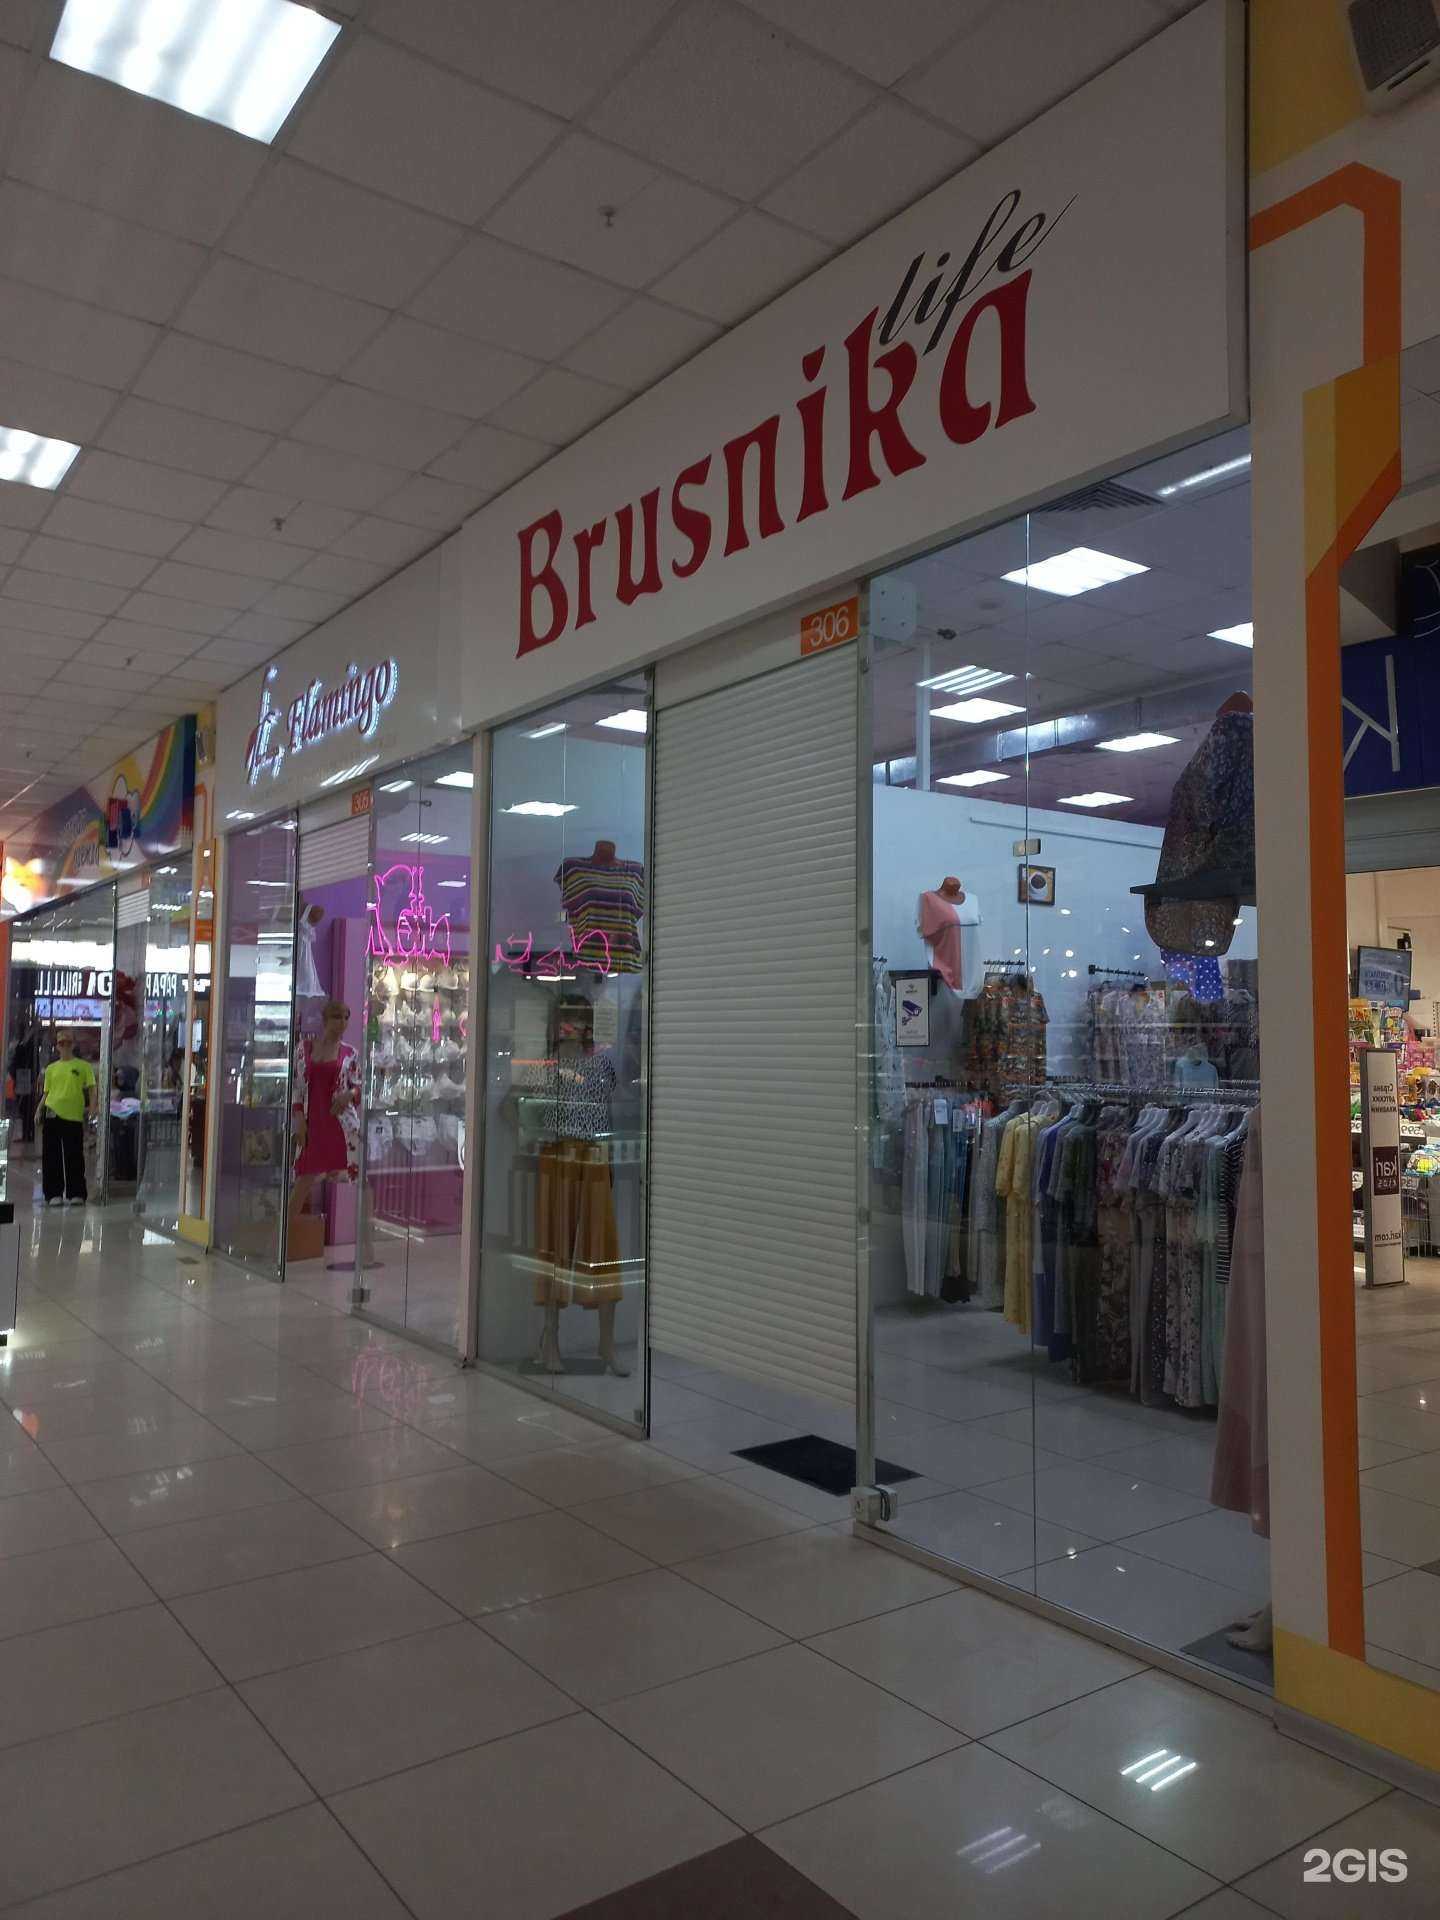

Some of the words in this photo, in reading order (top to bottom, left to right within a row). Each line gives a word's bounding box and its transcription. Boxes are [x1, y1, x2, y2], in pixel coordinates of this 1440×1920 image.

[877, 189, 1079, 356] life
[516, 268, 1037, 659] Brusnika
[810, 606, 849, 647] 306
[287, 656, 399, 754] Flamingo
